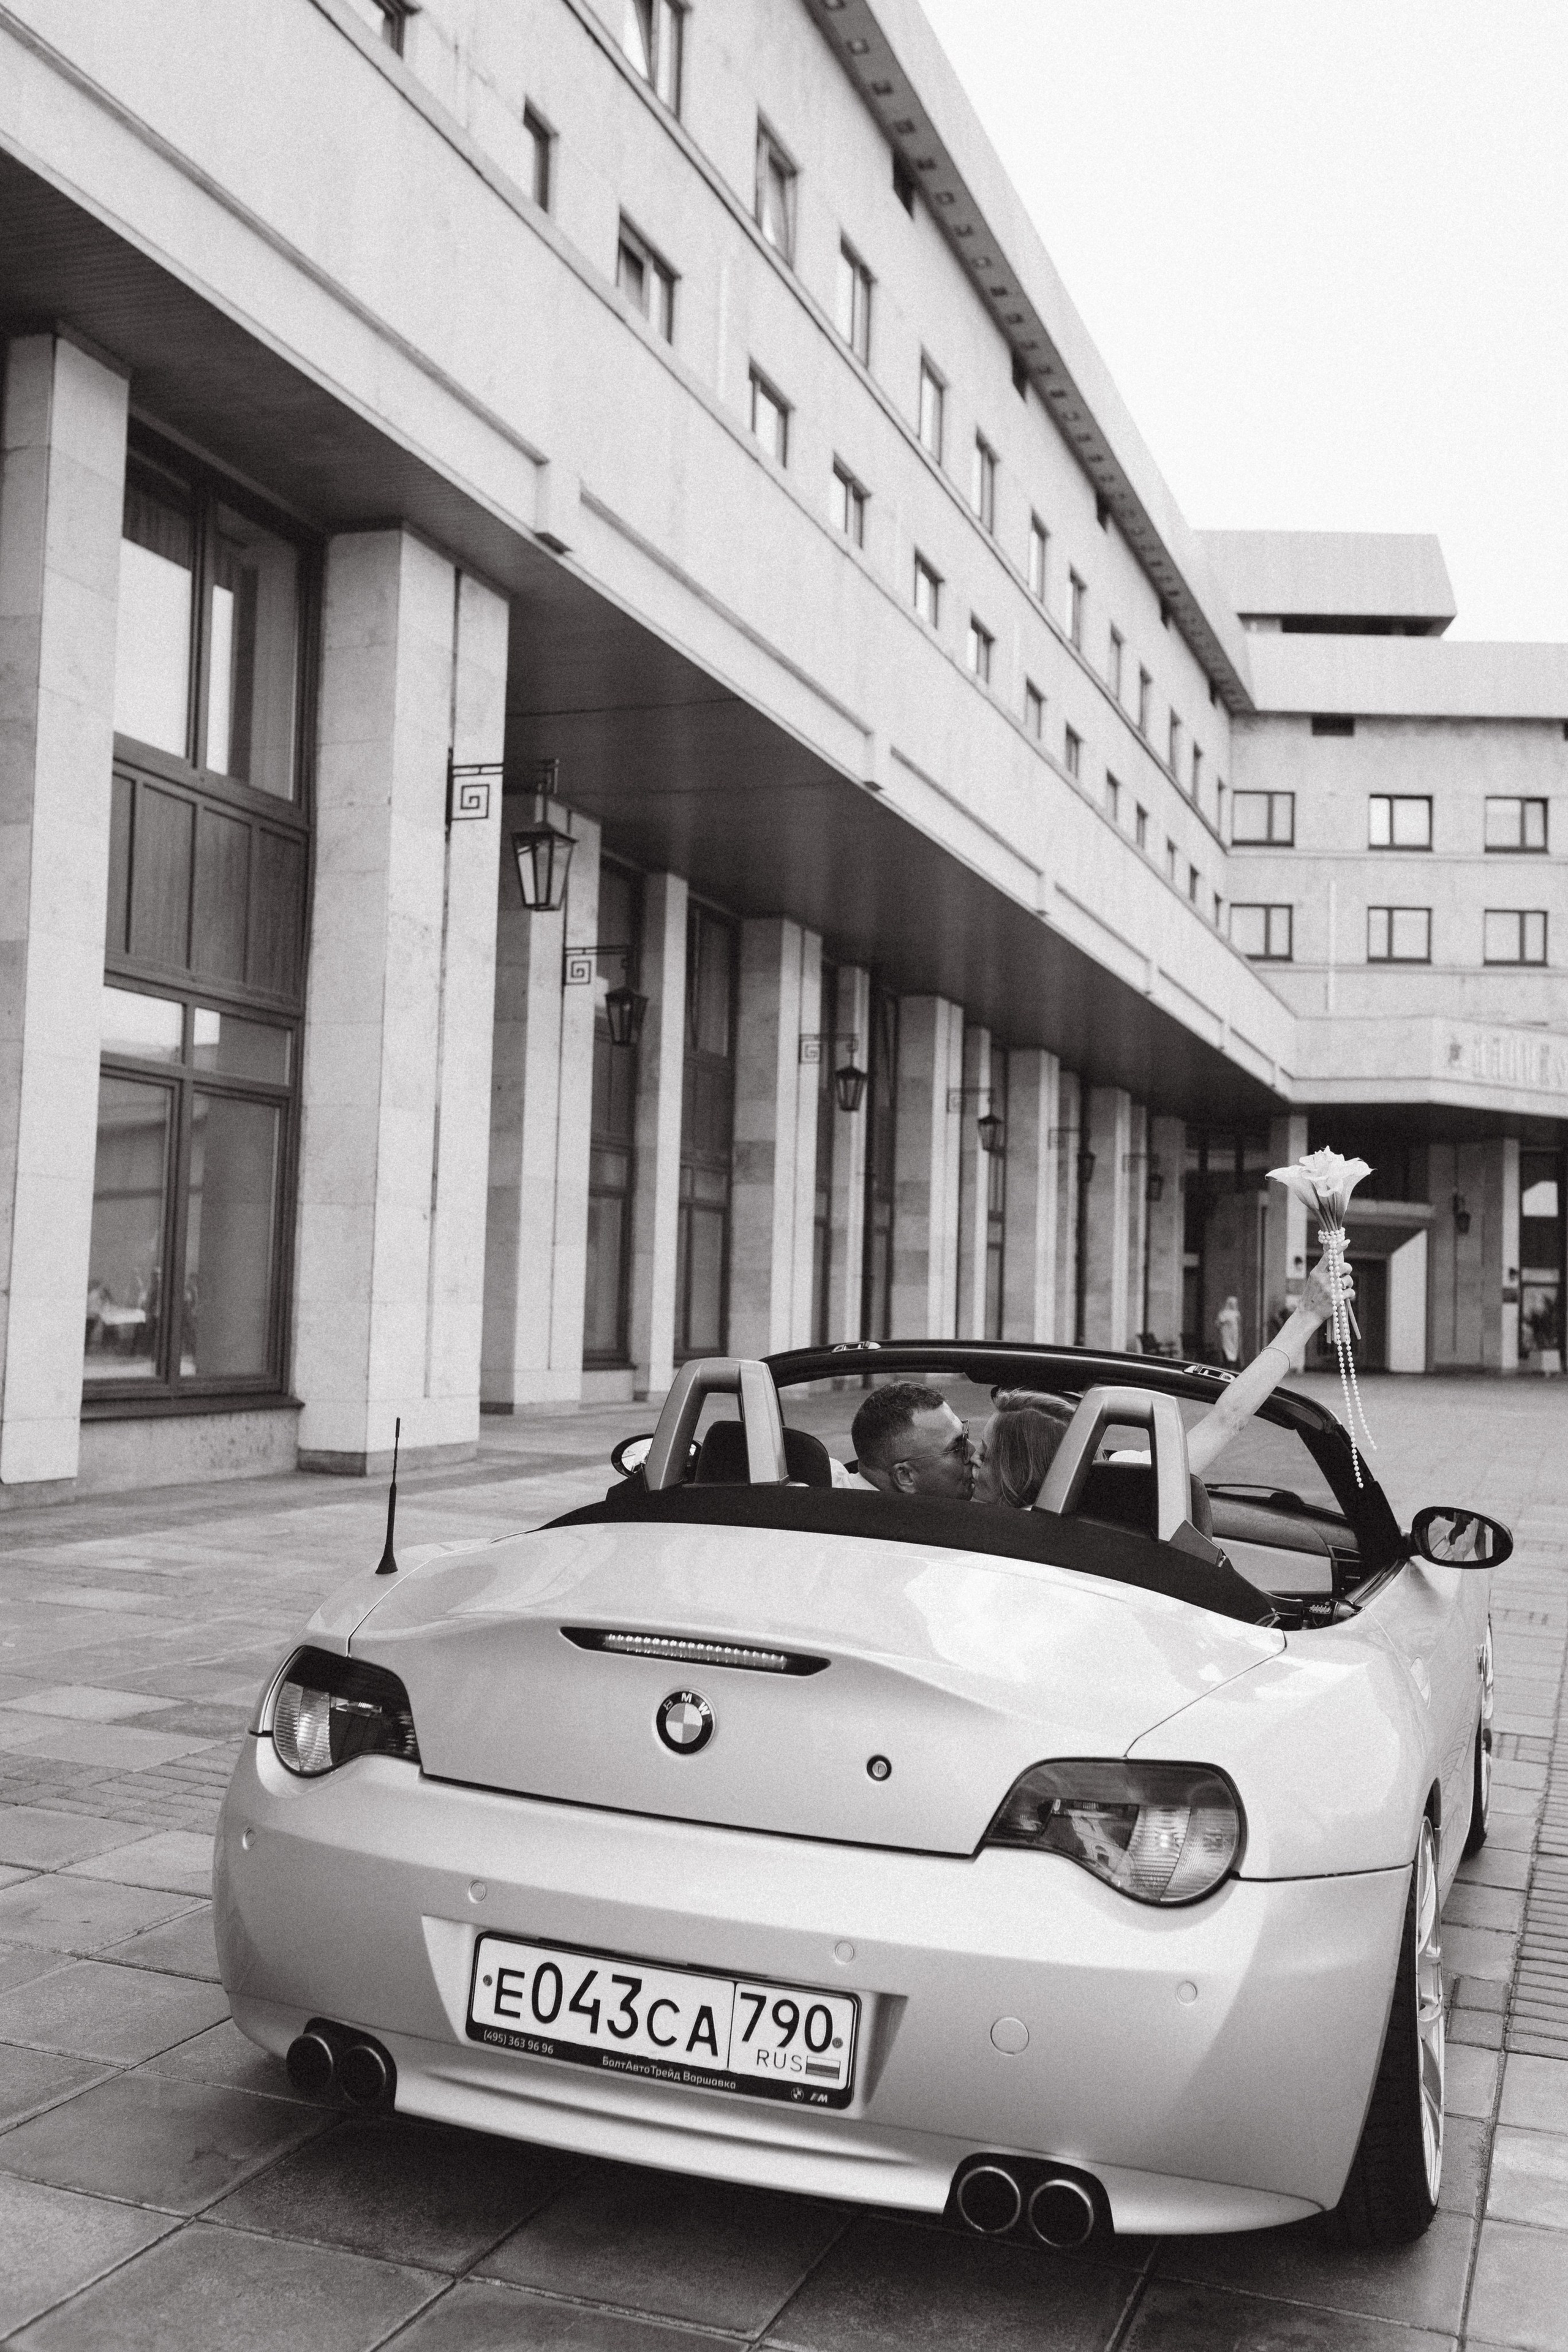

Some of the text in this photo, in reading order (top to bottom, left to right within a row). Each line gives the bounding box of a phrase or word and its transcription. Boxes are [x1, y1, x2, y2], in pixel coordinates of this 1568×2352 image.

[663, 1692, 710, 1716] BMW
[741, 1992, 833, 2052] 790
[483, 2029, 554, 2054] (495) 363 96 96
[756, 2049, 802, 2072] RUS
[683, 2070, 736, 2089] Варшавка
